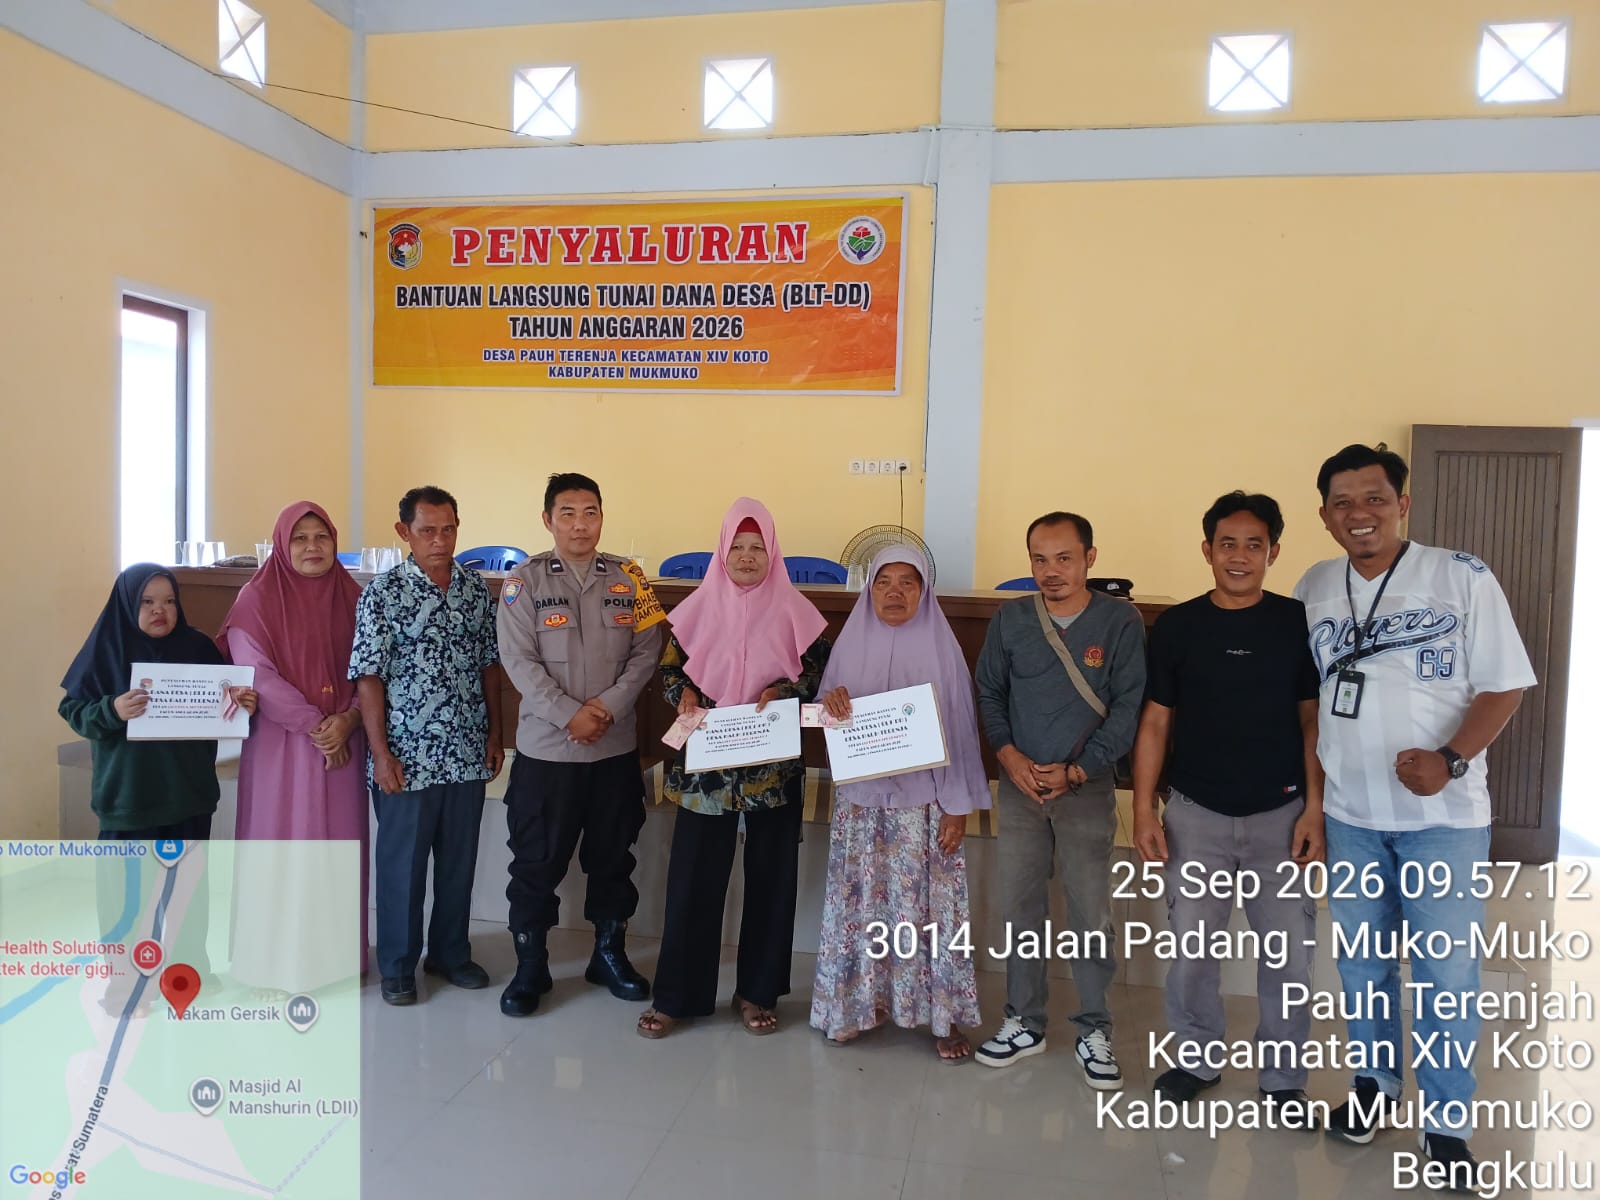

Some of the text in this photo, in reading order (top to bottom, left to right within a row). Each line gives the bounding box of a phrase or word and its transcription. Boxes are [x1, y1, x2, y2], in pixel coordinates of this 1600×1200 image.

[450, 223, 807, 264] PENYALURAN
[396, 282, 871, 310] BANTUAN LANGSUNG TUNAI DANA DESA (BLT-DD)
[509, 316, 743, 338] TAHUN ANGGARAN 2026
[483, 350, 768, 362] DESA PAUH TERENJA KECAMATAN XIV KOTO
[549, 366, 698, 379] KABUPATEN MUKMUKO
[535, 597, 569, 609] DARLAN
[1308, 608, 1460, 681] Players
[1416, 647, 1457, 681] 69
